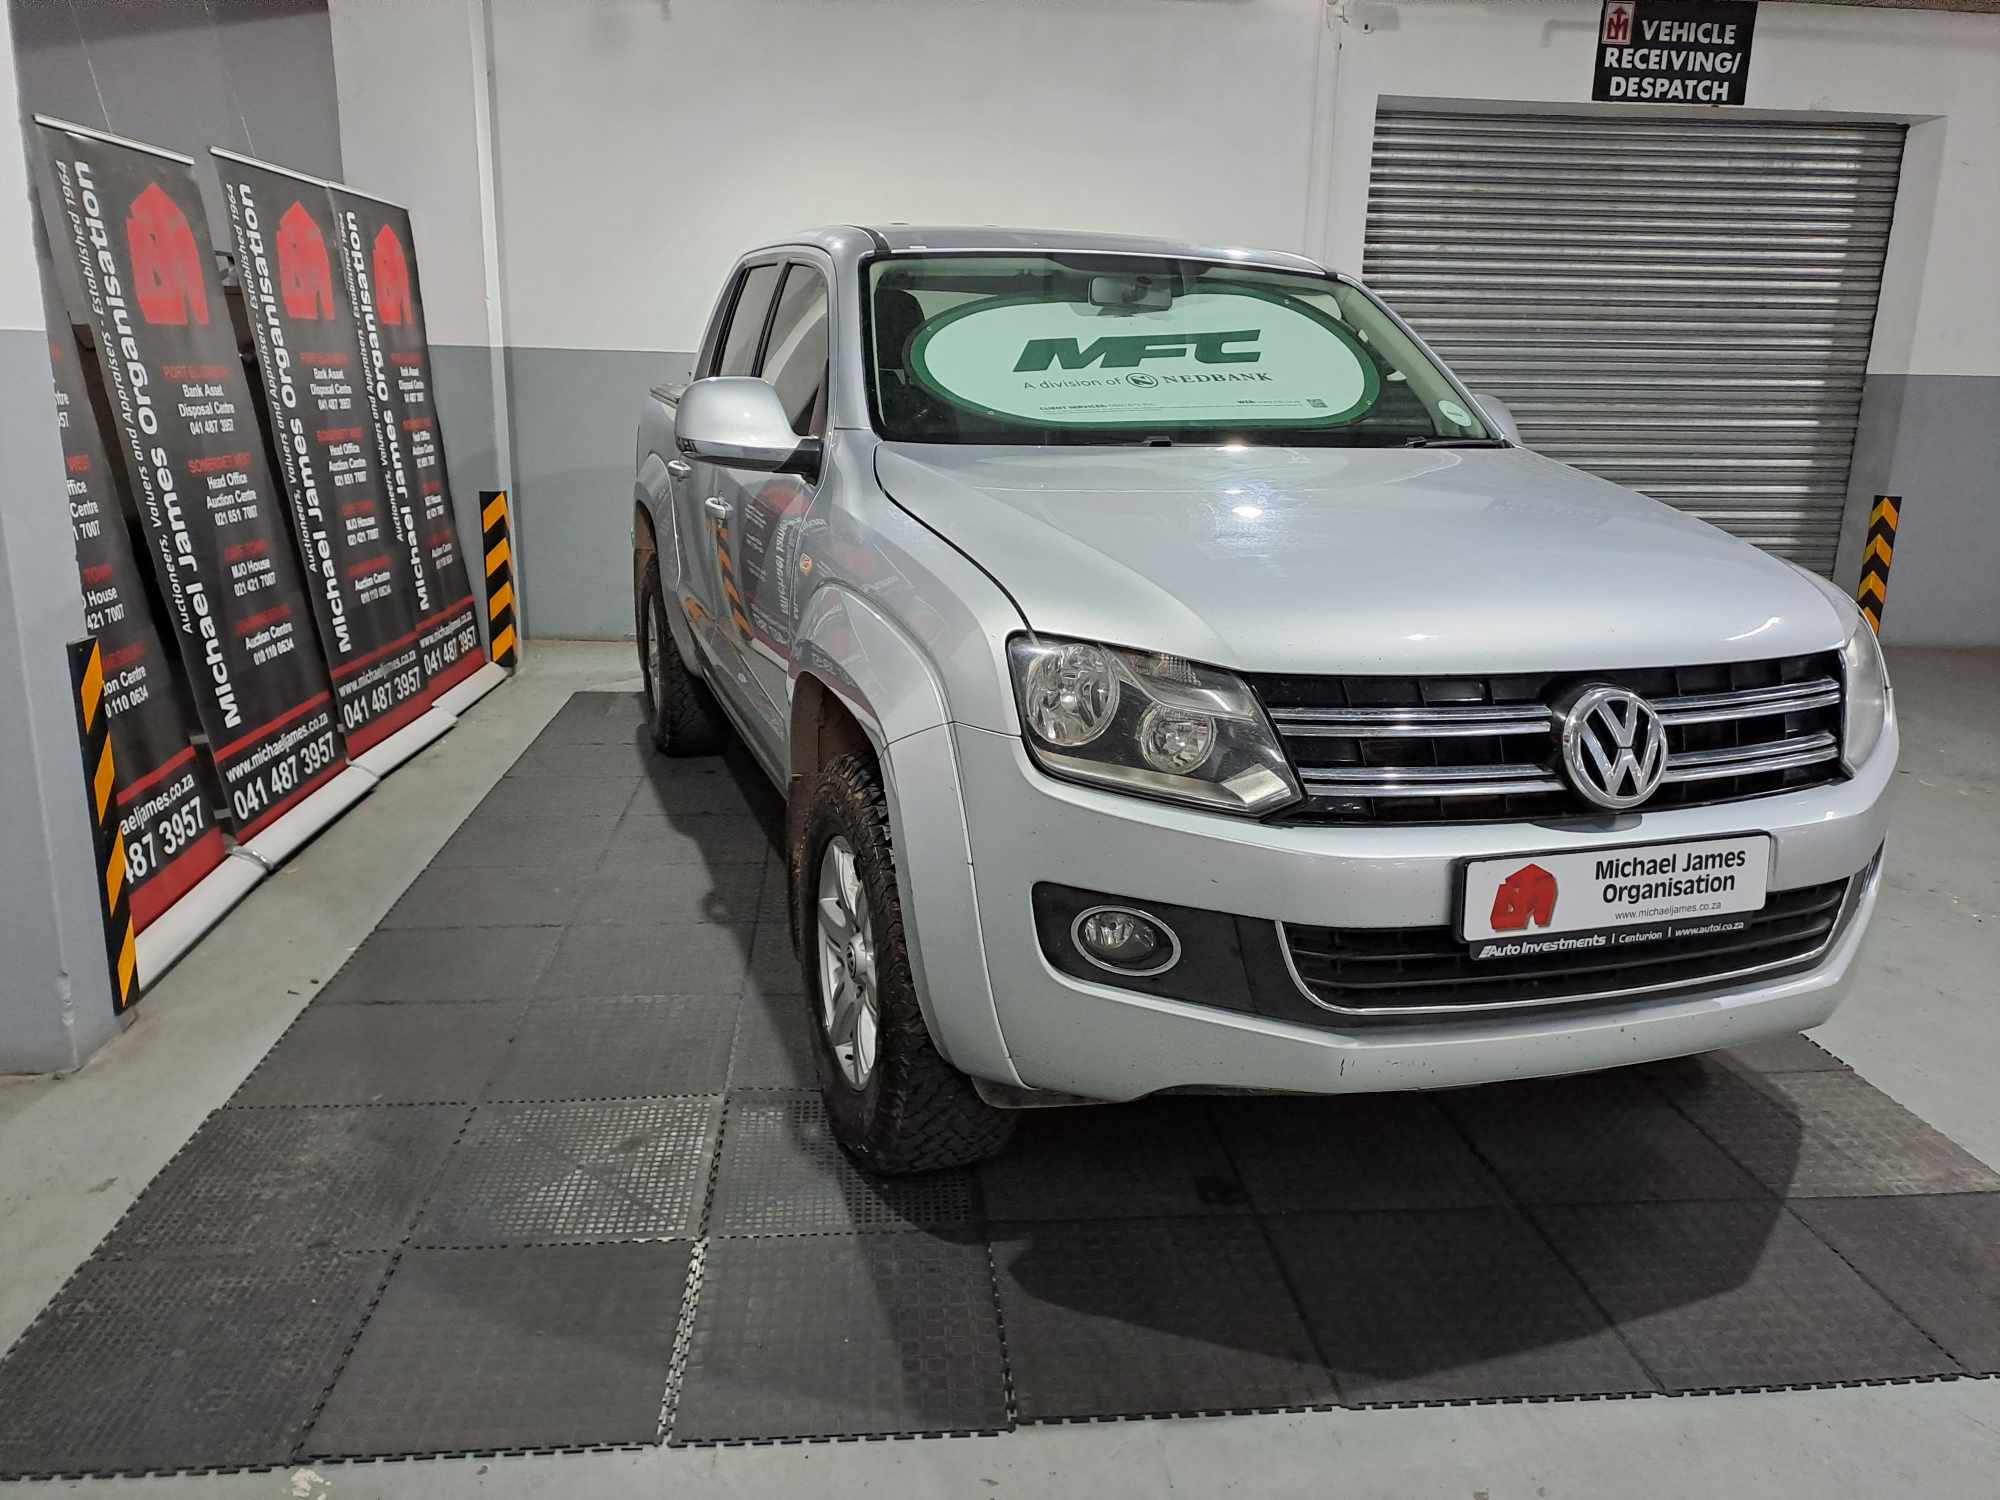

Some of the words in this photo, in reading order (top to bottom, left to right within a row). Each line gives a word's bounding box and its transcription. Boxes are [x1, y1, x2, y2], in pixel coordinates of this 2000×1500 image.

[1641, 20, 1737, 45] VEHICLE
[1604, 47, 1742, 74] RECEIVING/
[1609, 76, 1729, 101] DESPATCH
[68, 210, 105, 315] Established
[74, 161, 158, 435] Organisation
[239, 183, 297, 409] Organisation
[346, 211, 388, 402] Organisation
[1012, 329, 1261, 372] MFC
[102, 332, 134, 424] Appraisers
[1024, 382, 1036, 390] A
[1040, 379, 1103, 389] division
[1106, 376, 1122, 386] of
[1162, 372, 1273, 384] NEDBANK
[178, 402, 213, 419] Disposal
[125, 427, 144, 462] and
[383, 410, 408, 499] James
[289, 418, 323, 523] James
[69, 501, 99, 518] Centre
[138, 466, 162, 528] Valuers
[151, 447, 198, 572] James
[206, 493, 235, 509] Auction
[80, 520, 101, 539] 7007
[400, 505, 430, 610] Michael
[87, 586, 118, 608] House
[104, 603, 125, 624] 7007
[312, 530, 352, 654] Michael
[185, 582, 241, 729] Michael
[423, 648, 443, 675] 041
[443, 639, 457, 663] 487
[458, 625, 477, 653] 3957
[120, 664, 146, 687] Centre
[343, 696, 370, 729] 041
[371, 682, 393, 712] 487
[394, 666, 421, 700] 3957
[226, 712, 328, 783] www.michaeljames.co.za
[233, 776, 268, 820] 041
[271, 755, 298, 794] 487
[300, 731, 335, 775] 3957
[120, 773, 195, 836] aeljames.co.za
[158, 795, 205, 855] 3957
[1595, 853, 1677, 880] Michael
[1682, 849, 1746, 872] James
[1602, 873, 1736, 904] Organisation
[1614, 901, 1722, 920] www.michaeljames.co.za
[1619, 930, 1663, 944] Centurion
